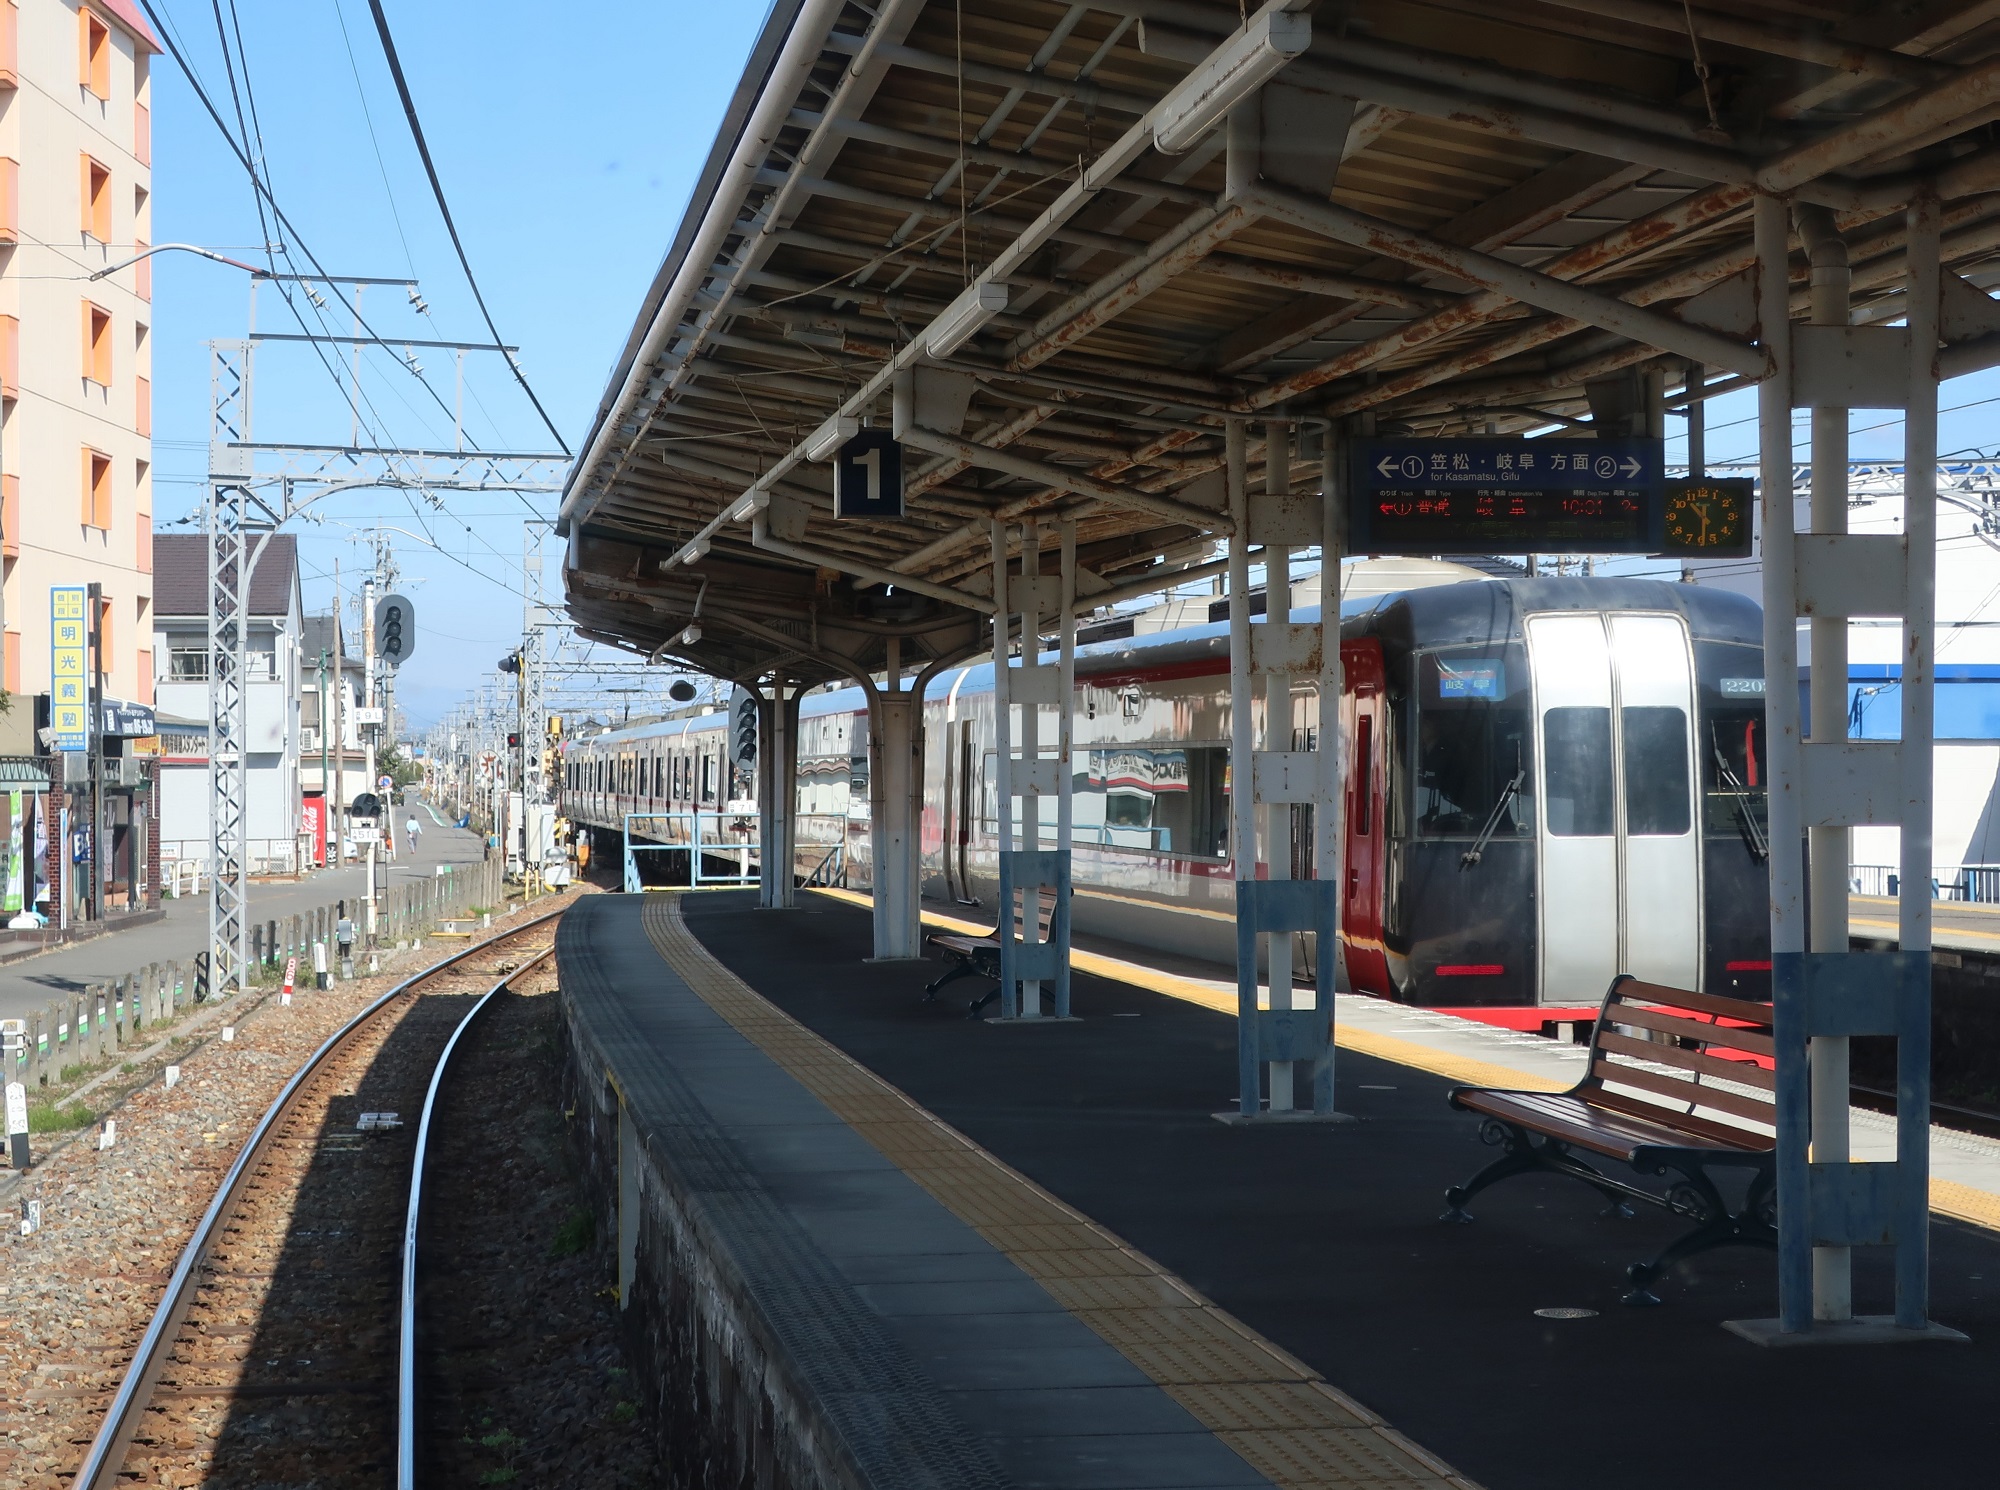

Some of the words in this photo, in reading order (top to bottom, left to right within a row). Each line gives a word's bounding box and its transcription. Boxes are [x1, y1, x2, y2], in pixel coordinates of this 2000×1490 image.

[1430, 453, 1534, 470] 笠松・岐阜
[1550, 453, 1589, 470] 方面
[852, 448, 880, 499] 1
[1430, 472, 1443, 481] for
[1446, 472, 1498, 482] Kasamatsu,
[1501, 472, 1520, 481] Gifu
[1698, 490, 1708, 498] 12
[1675, 526, 1682, 534] 8
[61, 626, 76, 727] 明光義塾
[1726, 680, 1766, 692] 220
